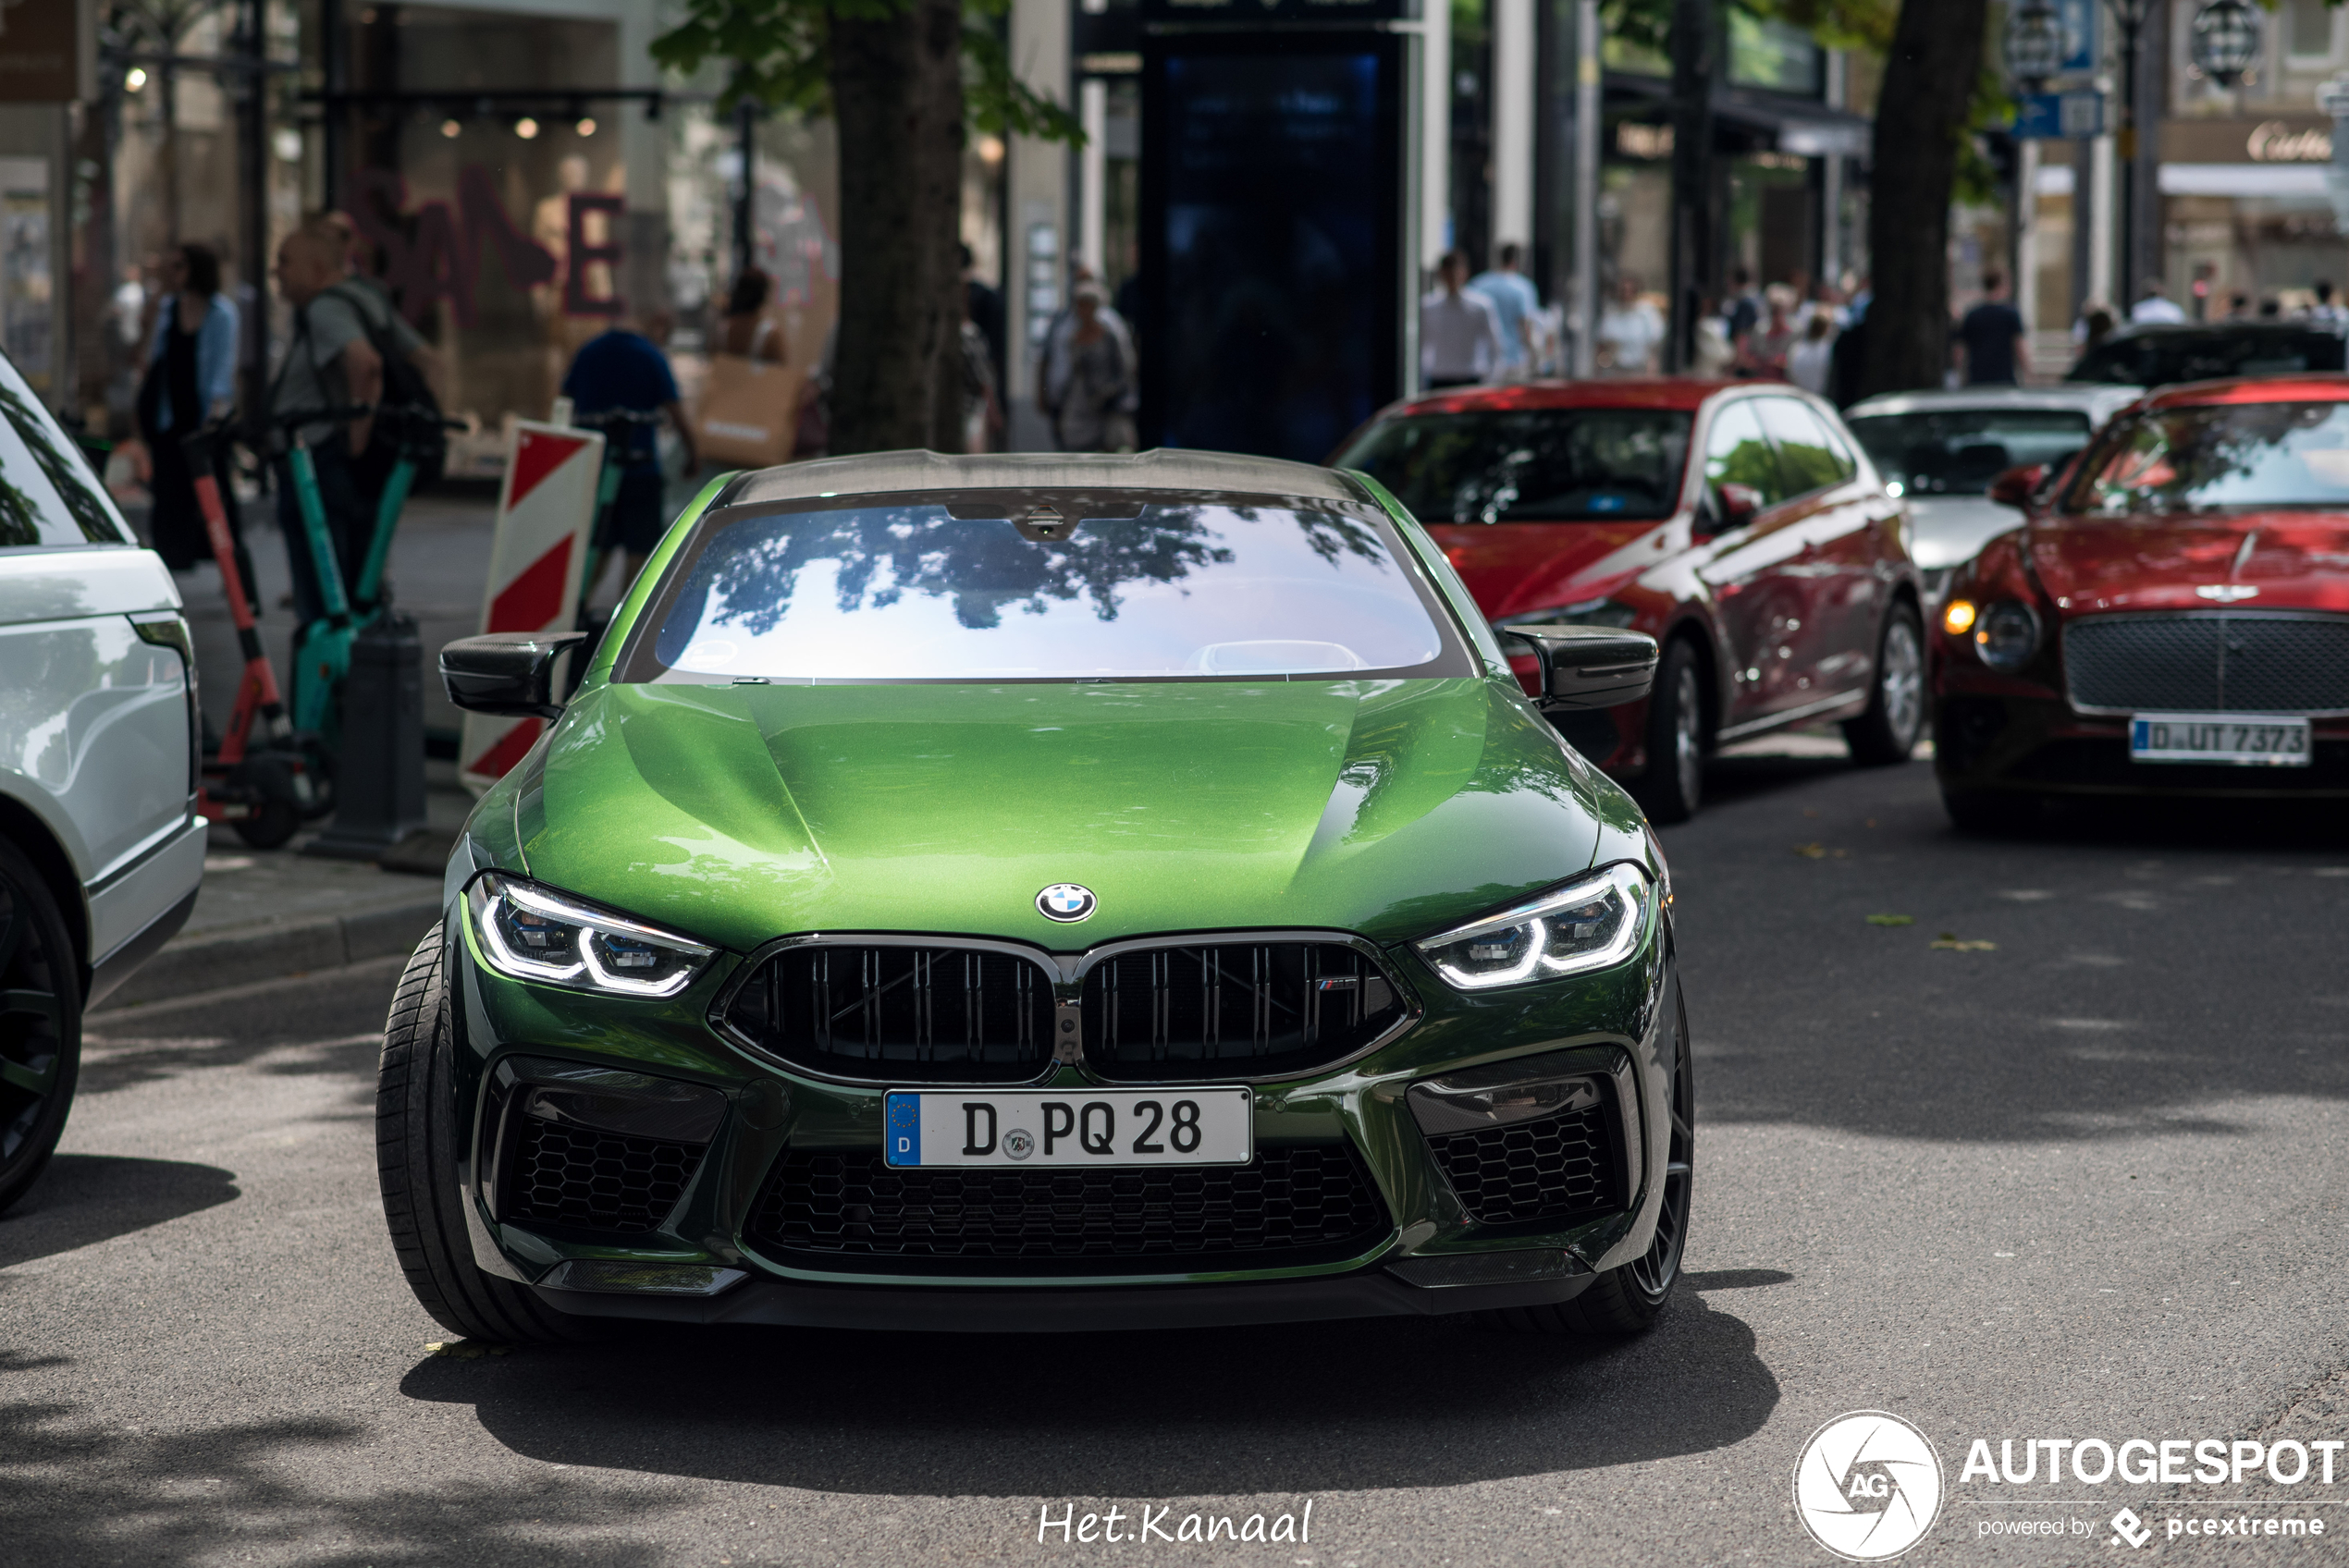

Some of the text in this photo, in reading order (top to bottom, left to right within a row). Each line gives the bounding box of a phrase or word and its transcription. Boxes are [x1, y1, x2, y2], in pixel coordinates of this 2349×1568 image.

[2151, 724, 2306, 753] D UT 7373
[962, 1102, 998, 1156] D
[1040, 1101, 1115, 1156] PQ
[1132, 1099, 1202, 1154] 28
[898, 1137, 910, 1153] D
